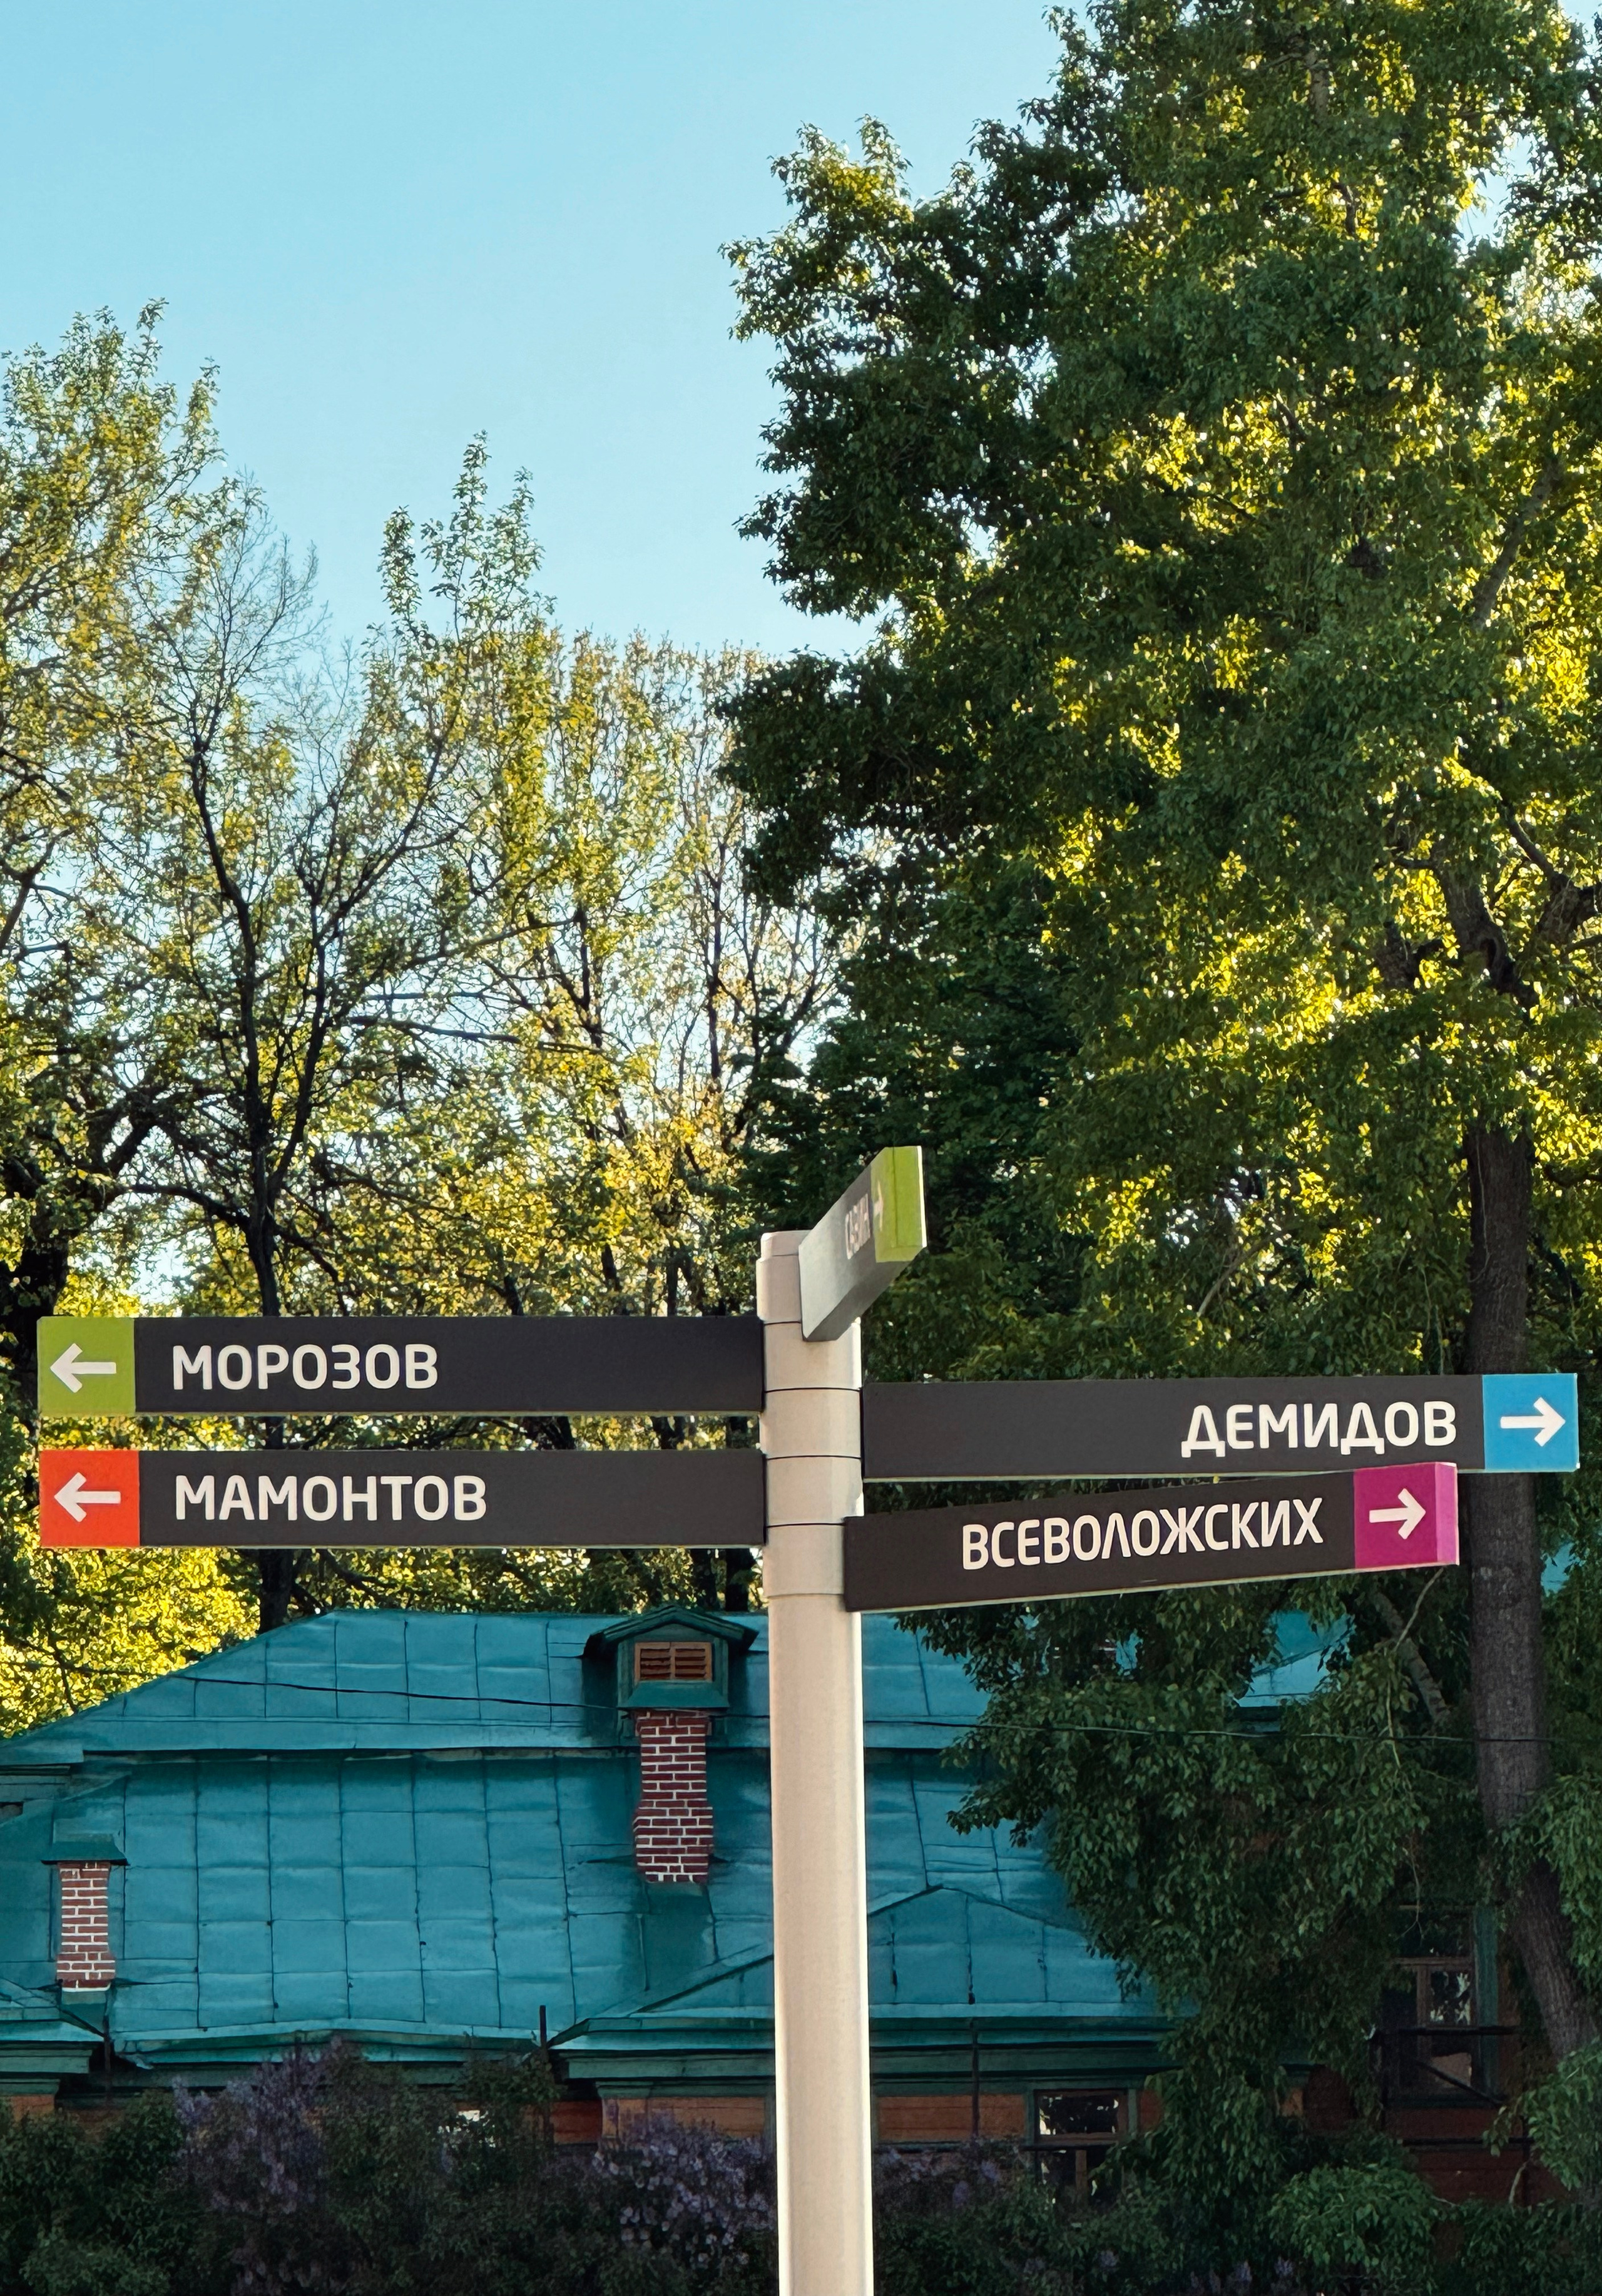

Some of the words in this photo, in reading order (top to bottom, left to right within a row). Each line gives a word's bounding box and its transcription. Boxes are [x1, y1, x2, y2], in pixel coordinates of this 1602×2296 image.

[172, 1343, 439, 1391] МОРОЗОВ
[1180, 1400, 1457, 1459] ДЕМИДОВ
[175, 1474, 487, 1522] МАМОНТОВ
[962, 1497, 1324, 1571] ВСЕВОЛОЖСКИХ
